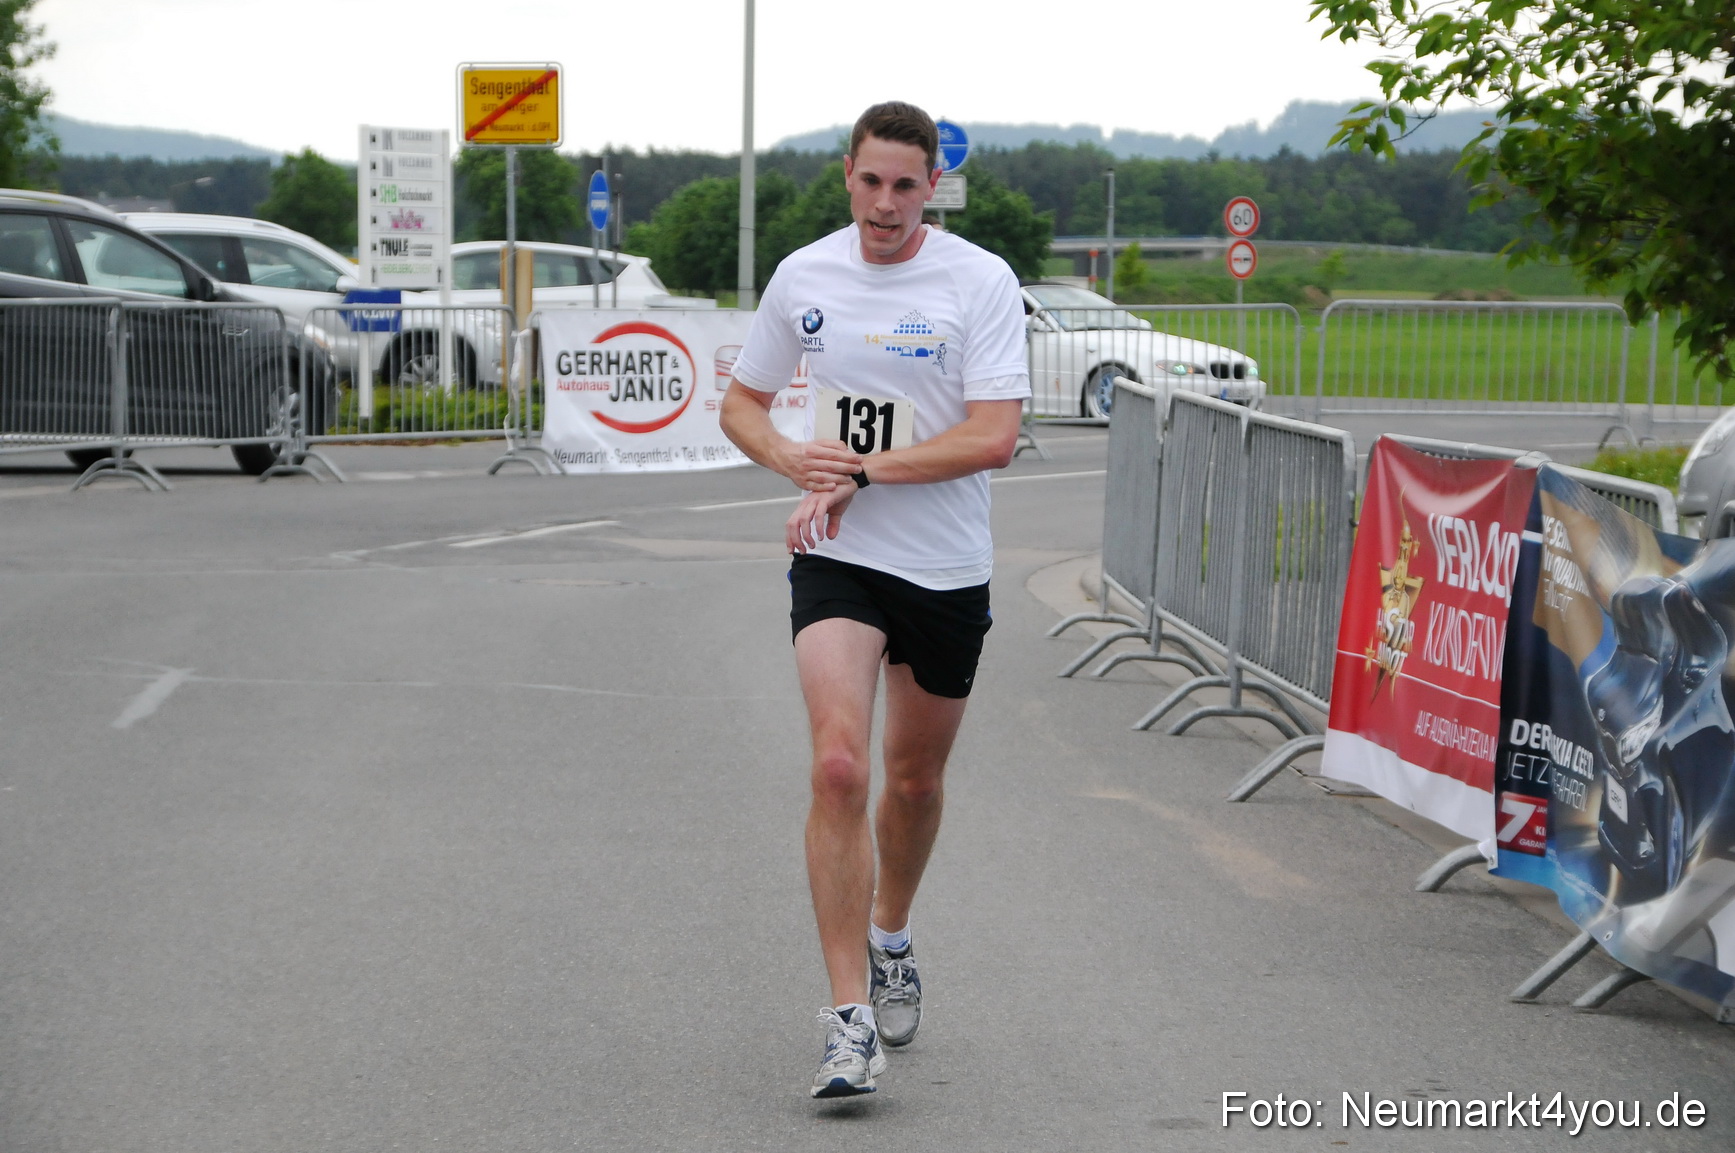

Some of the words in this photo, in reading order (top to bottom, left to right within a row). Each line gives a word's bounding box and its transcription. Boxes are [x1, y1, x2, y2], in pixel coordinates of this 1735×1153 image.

[470, 76, 550, 100] Sengenthal
[481, 102, 498, 112] am
[1233, 208, 1252, 226] 60
[379, 238, 408, 256] THULE
[801, 336, 824, 346] PARTL
[864, 334, 883, 345] 14.
[556, 349, 668, 376] GERHART
[671, 355, 680, 369] &
[556, 378, 610, 391] Autohaus
[609, 375, 683, 402] JÄNIG
[836, 395, 895, 455] 131
[554, 448, 609, 464] Neumarkt
[614, 446, 672, 467] Sengenthal
[1414, 710, 1432, 737] AUF
[1509, 718, 1552, 751] DER
[1497, 798, 1537, 844] 7
